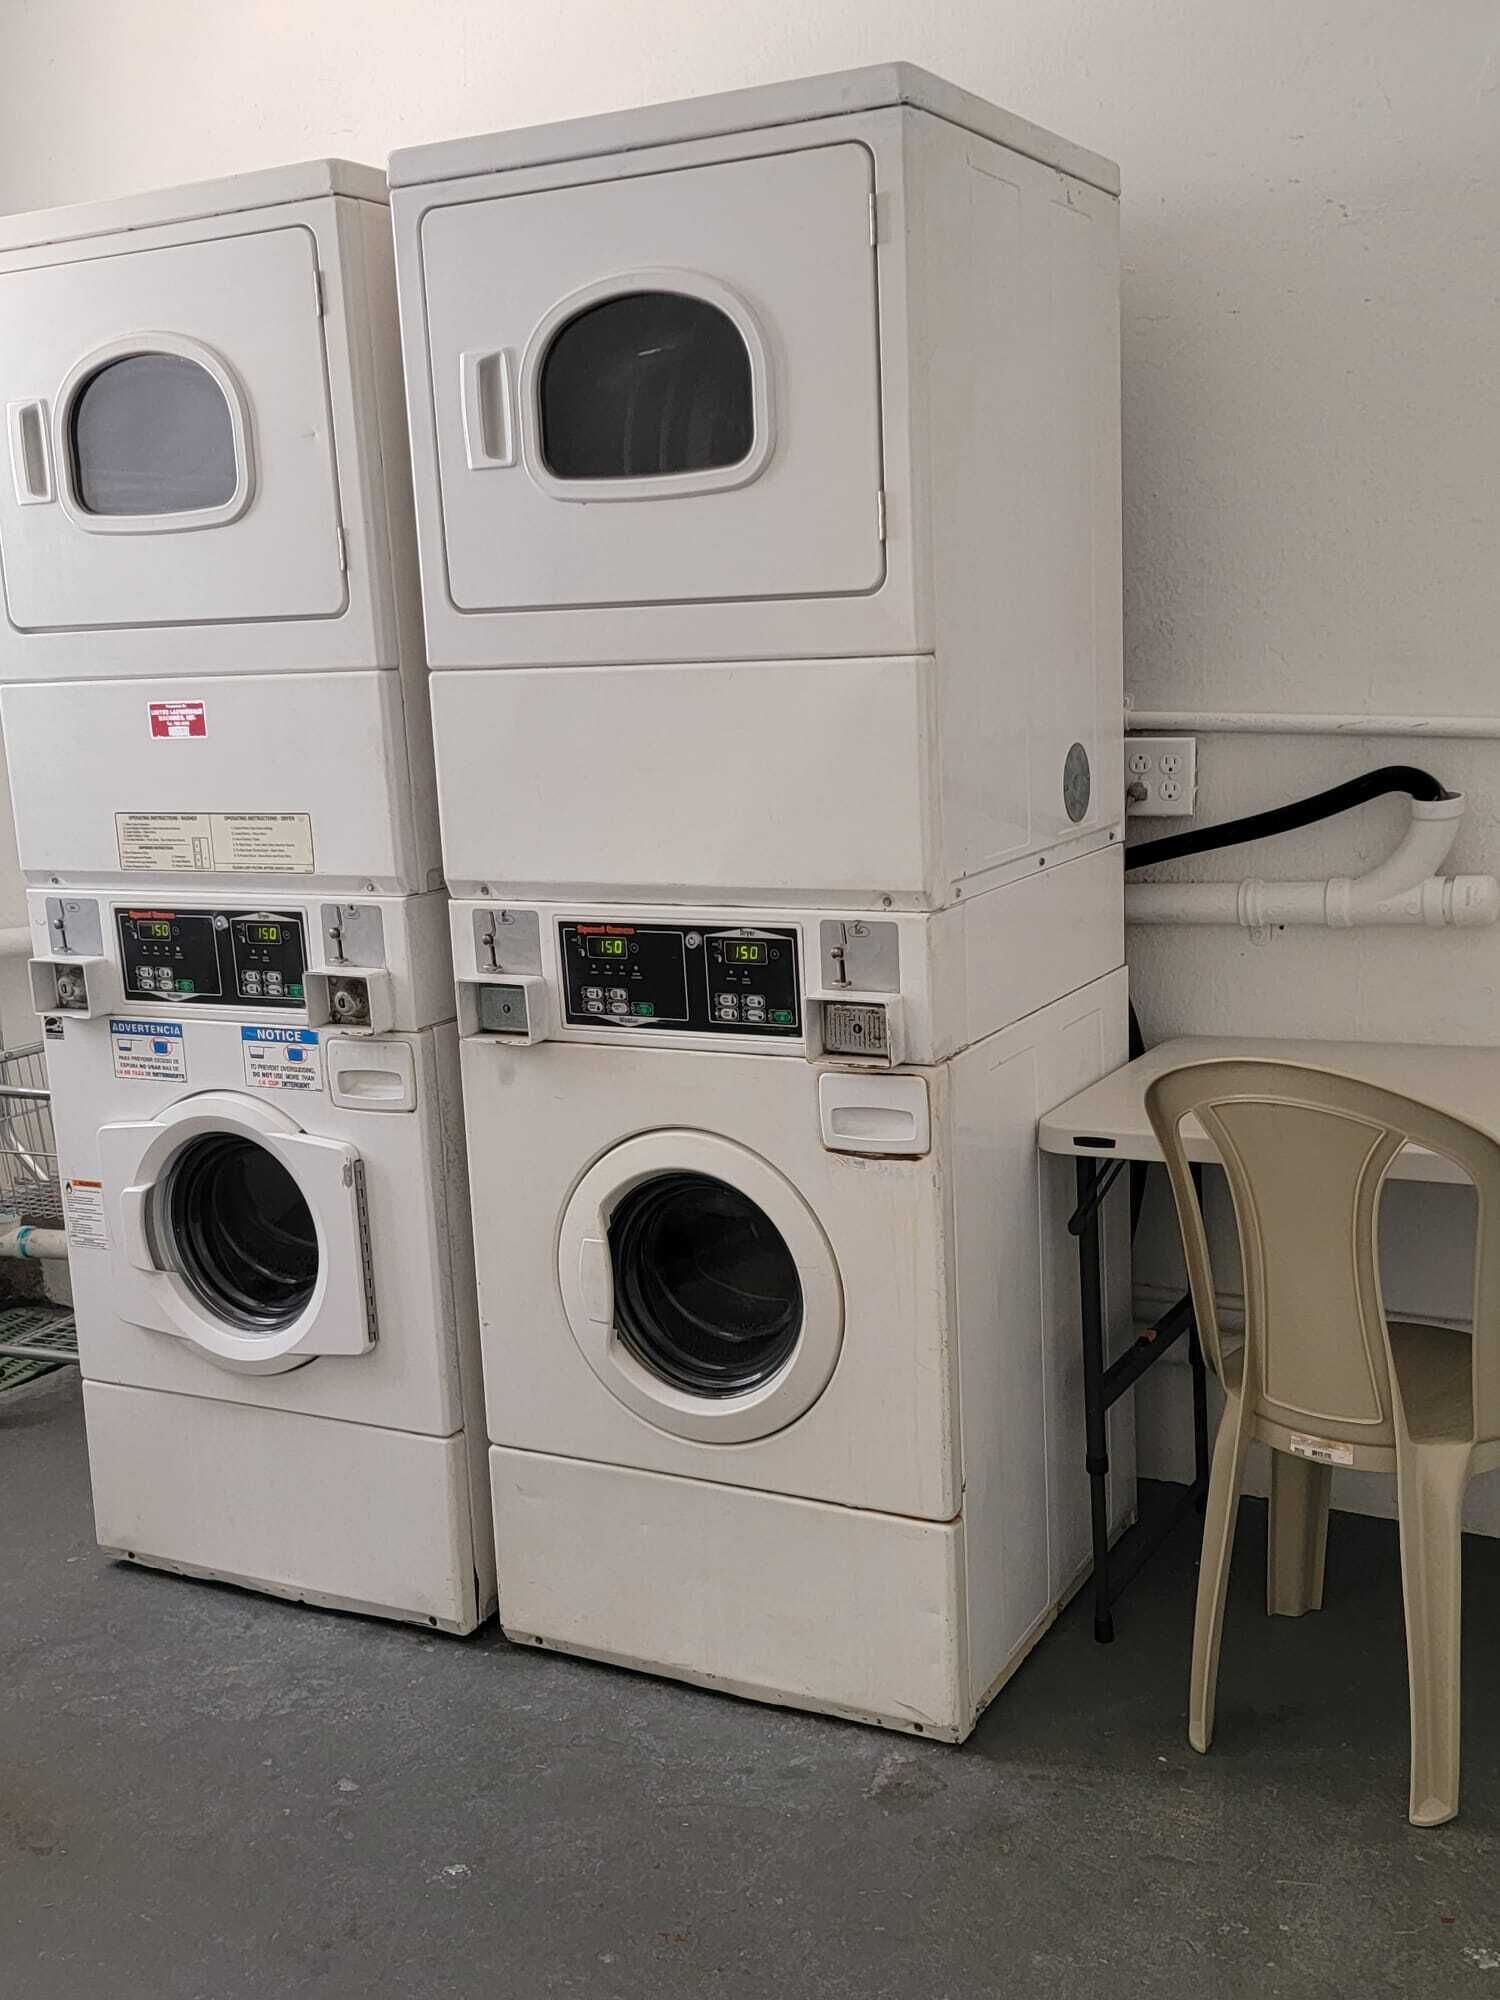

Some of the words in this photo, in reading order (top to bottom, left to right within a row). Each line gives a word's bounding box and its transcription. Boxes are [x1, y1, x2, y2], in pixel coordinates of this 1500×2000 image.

[151, 924, 169, 937] 150
[258, 927, 277, 940] 150
[601, 940, 622, 953] 150
[735, 946, 758, 960] 150
[112, 1022, 181, 1035] ADVERTENCIA
[256, 1029, 302, 1042] NOTICE
